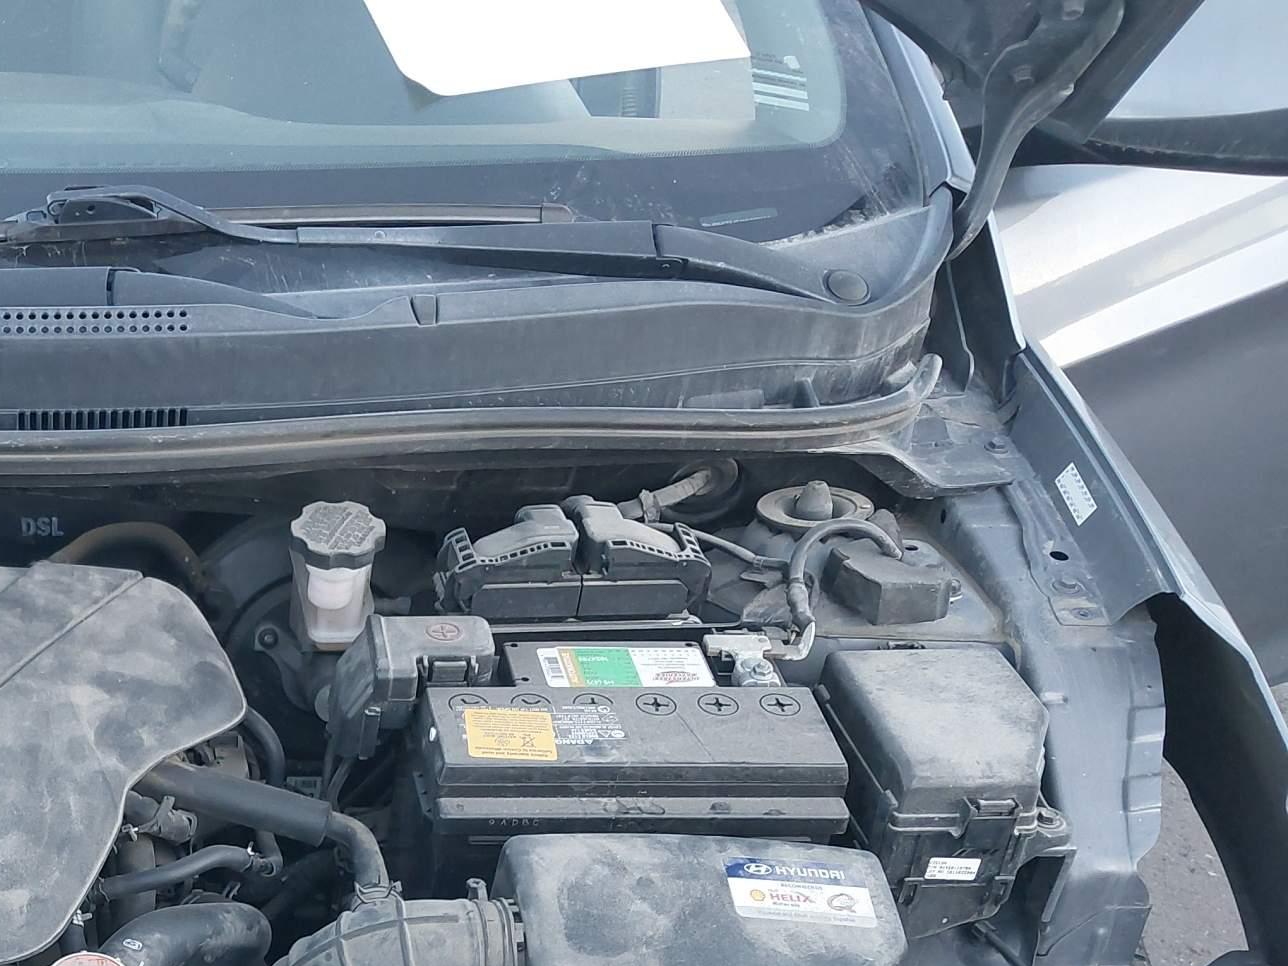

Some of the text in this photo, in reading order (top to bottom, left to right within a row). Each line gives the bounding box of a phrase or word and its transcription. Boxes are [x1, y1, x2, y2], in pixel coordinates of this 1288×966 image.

[21, 517, 64, 536] DSL
[774, 865, 847, 880] HYUNDAI
[769, 892, 815, 904] HELIX
